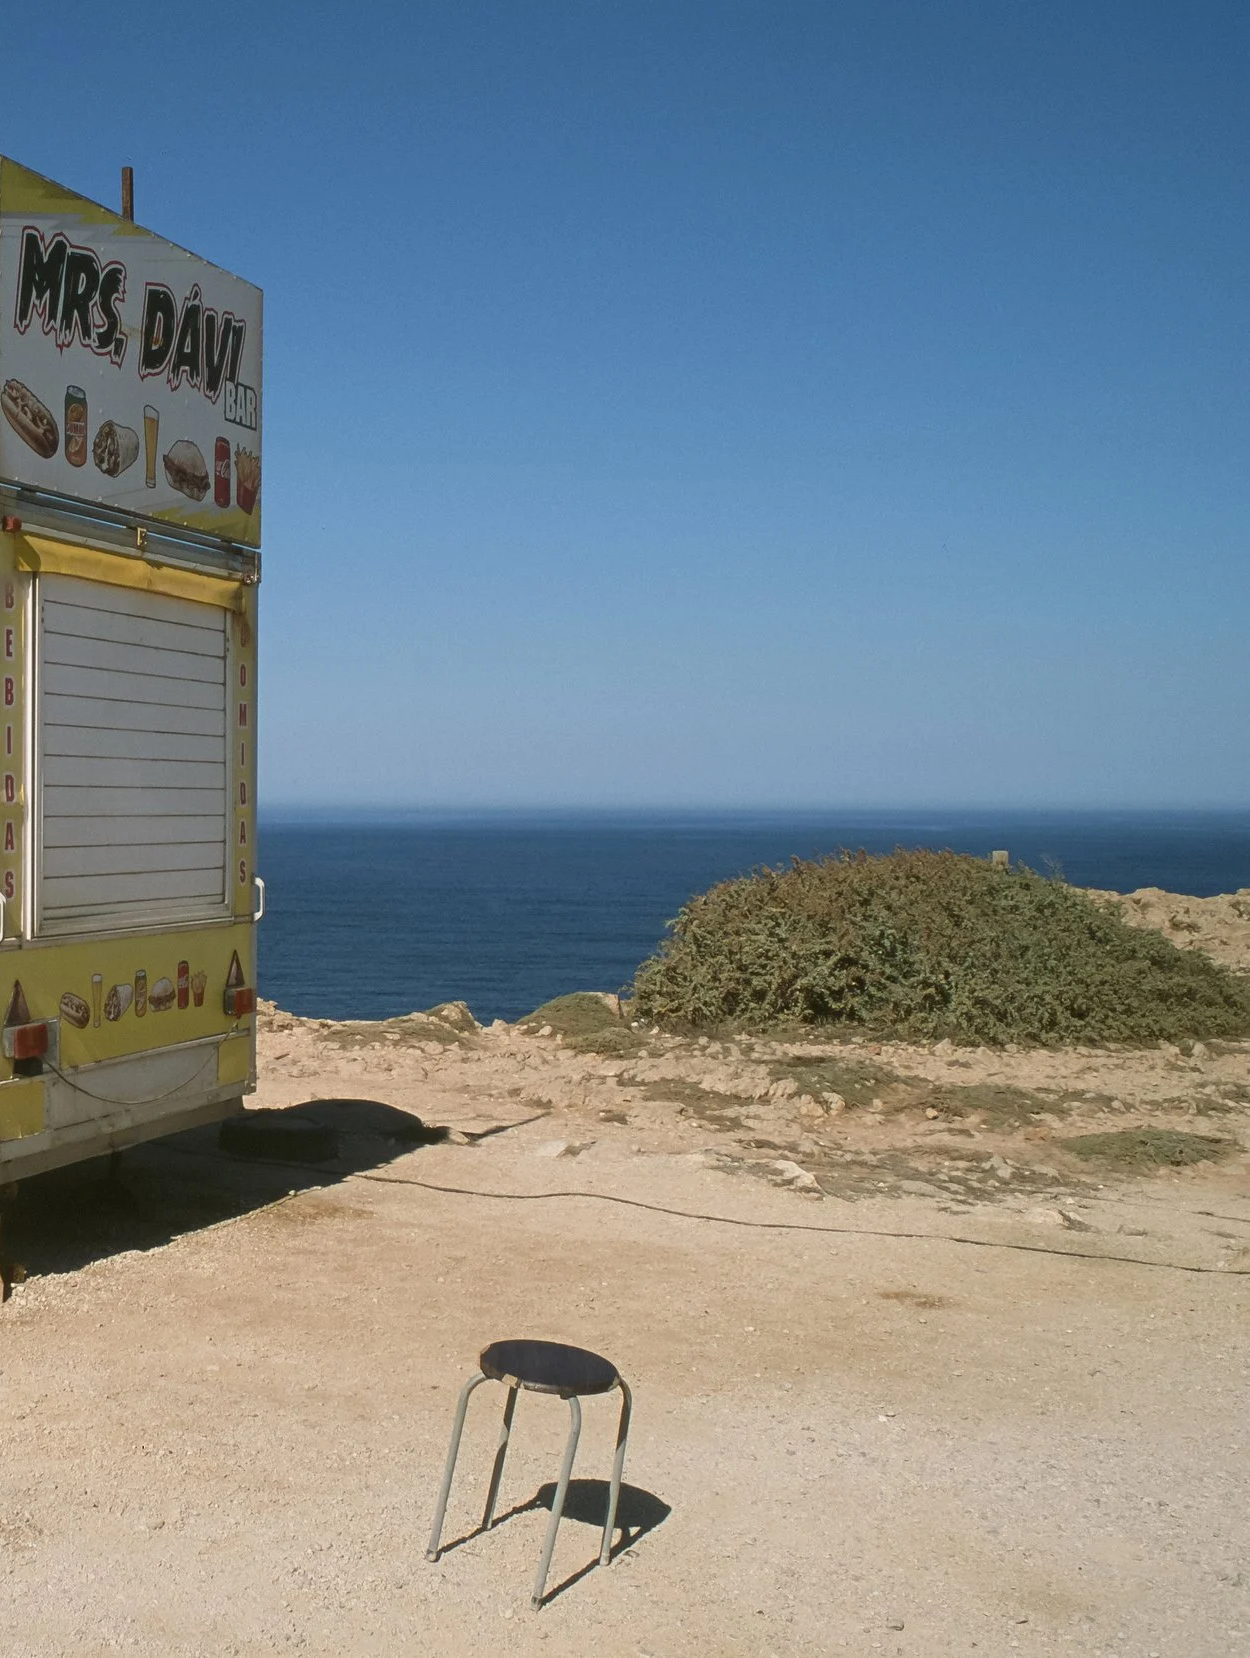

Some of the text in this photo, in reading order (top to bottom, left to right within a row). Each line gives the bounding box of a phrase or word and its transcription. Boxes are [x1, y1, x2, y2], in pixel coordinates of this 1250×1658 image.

[139, 283, 246, 402] DÁVI
[225, 380, 257, 431] BAR
[3, 581, 15, 899] BEBIDAS
